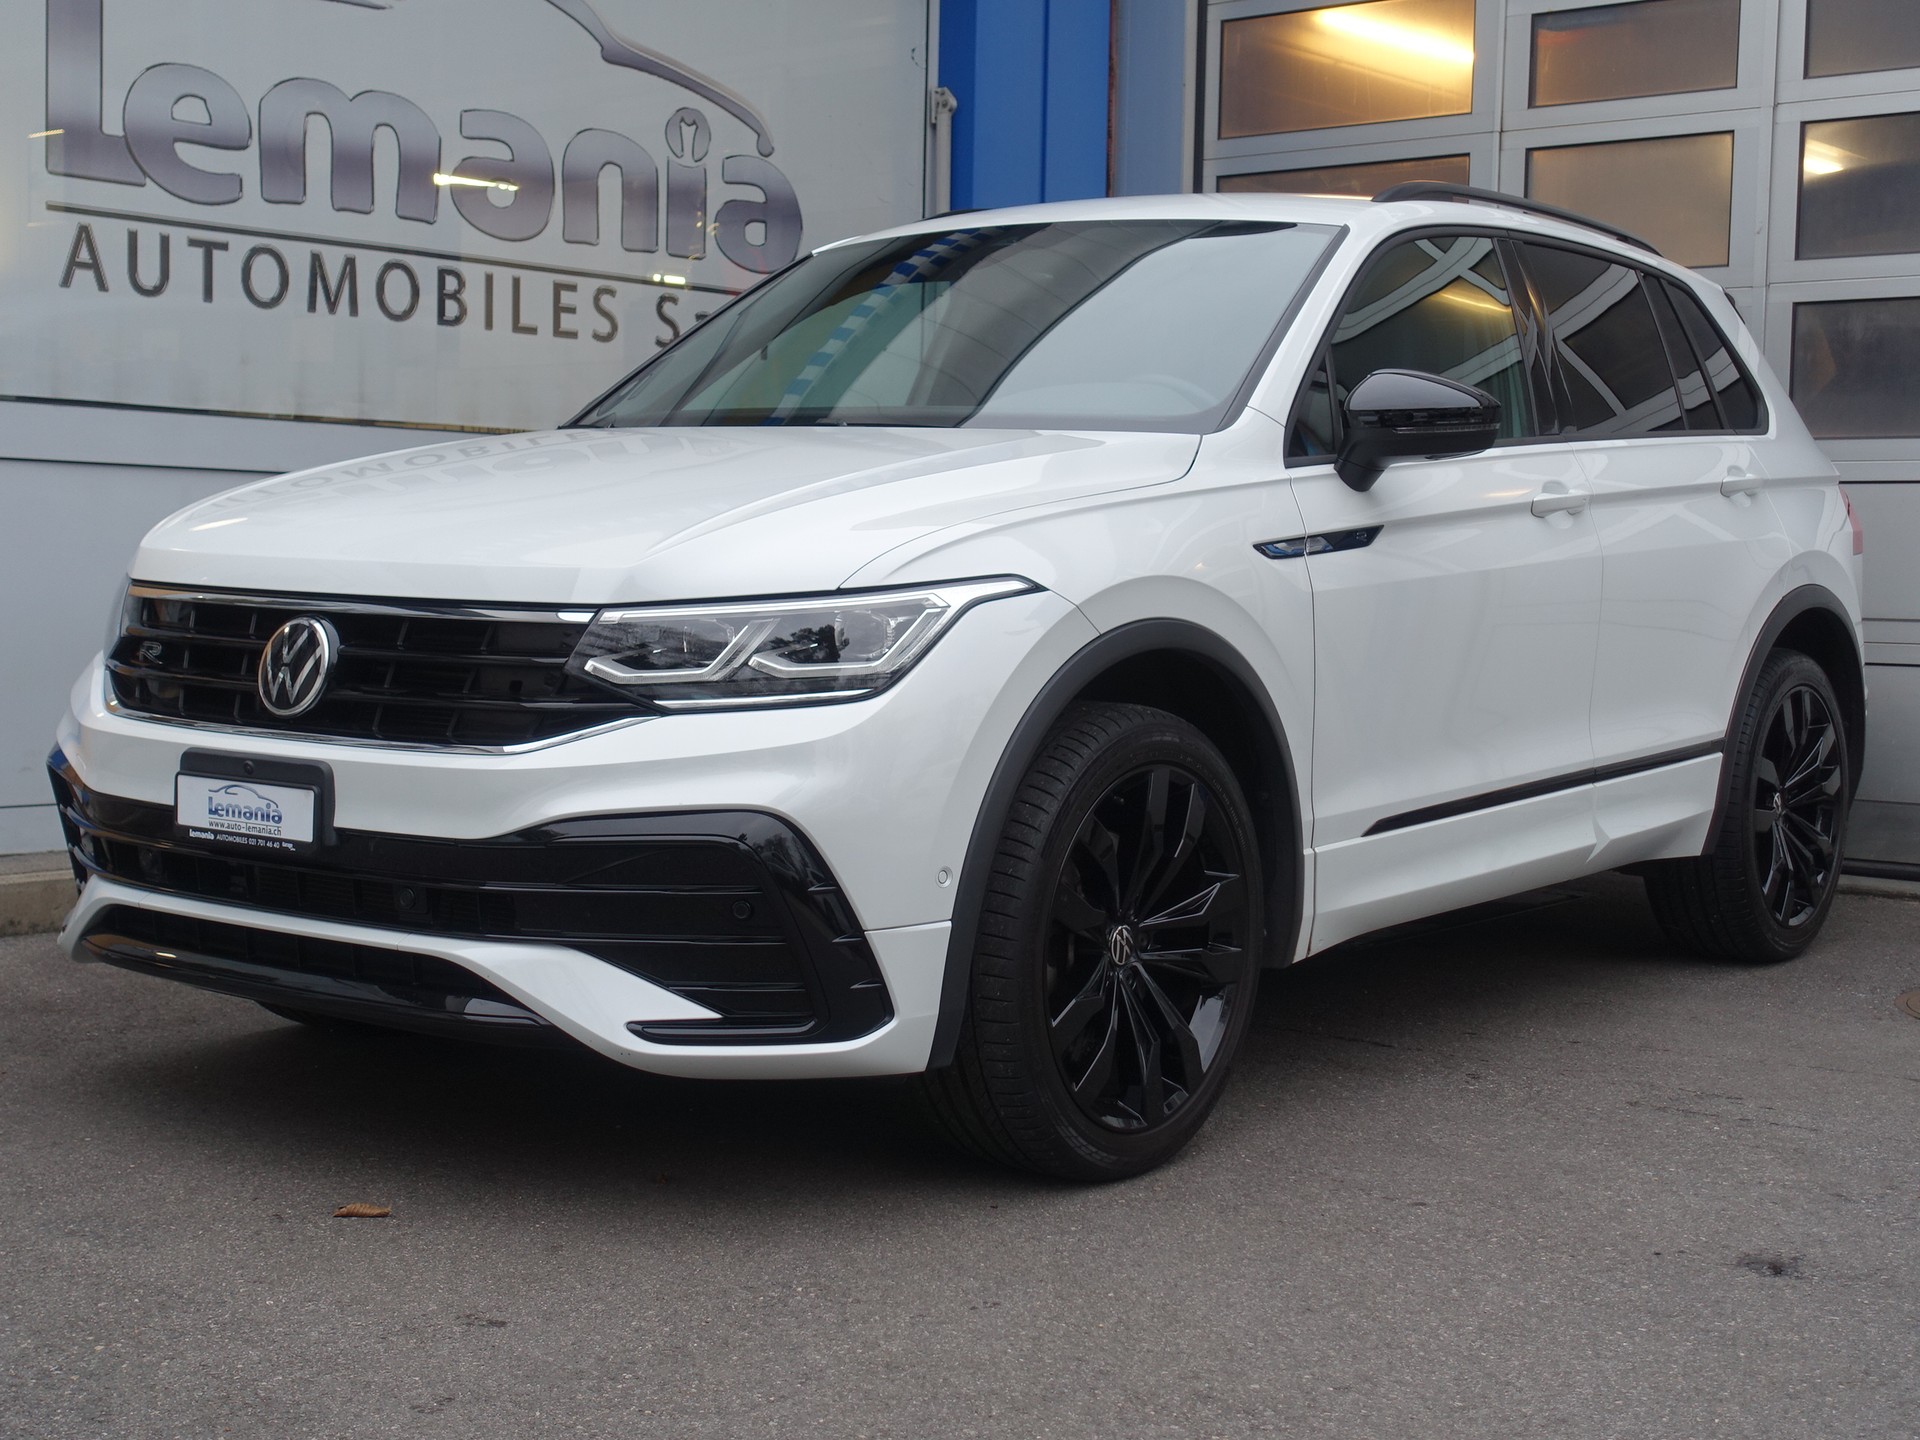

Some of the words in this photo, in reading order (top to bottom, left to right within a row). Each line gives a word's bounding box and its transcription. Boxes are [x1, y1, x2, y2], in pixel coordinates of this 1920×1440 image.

[46, 0, 802, 274] Lemania
[60, 222, 619, 343] AUTOMOBILES
[208, 796, 283, 825] Lemania
[208, 820, 282, 836] www.auto-lemania.ch
[216, 833, 248, 844] AUTOMOBILES
[257, 838, 266, 847] 701
